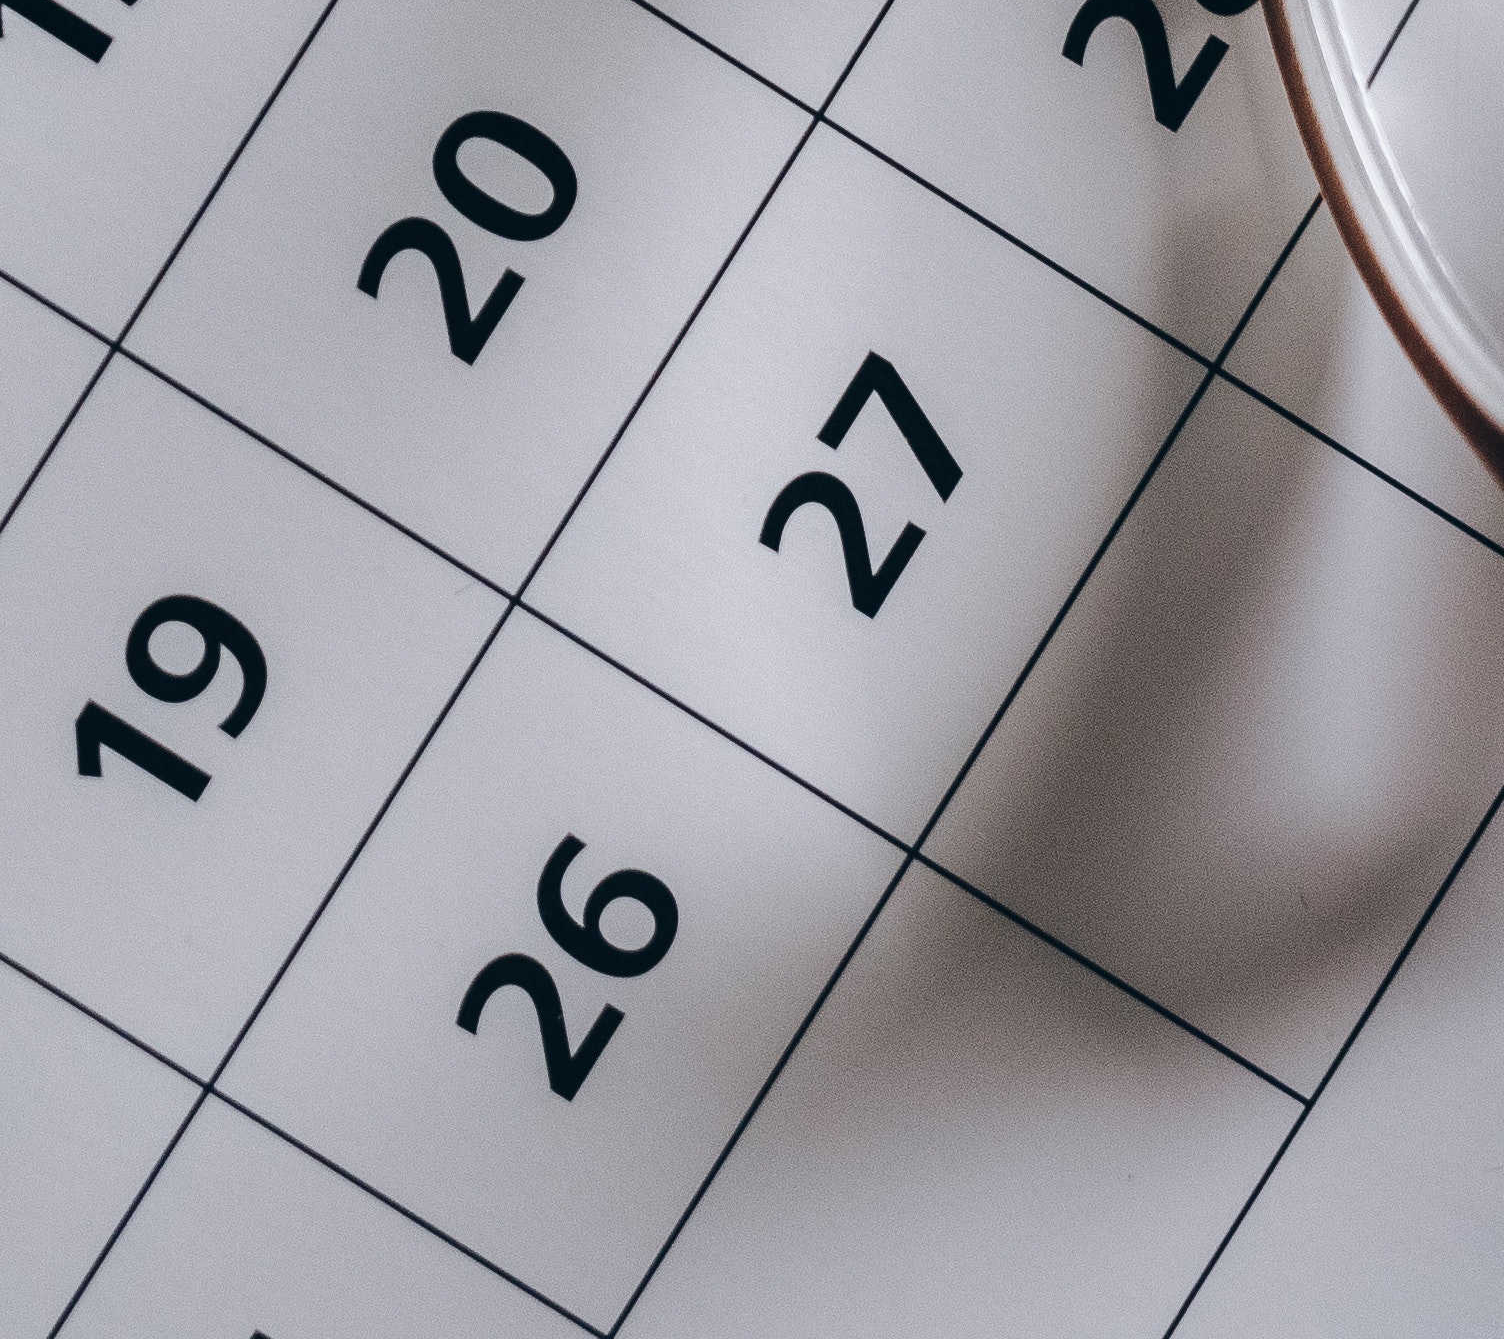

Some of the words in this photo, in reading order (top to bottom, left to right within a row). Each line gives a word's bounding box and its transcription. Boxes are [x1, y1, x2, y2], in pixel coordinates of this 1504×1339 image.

[357, 111, 577, 366] 20
[759, 351, 963, 619] 27
[75, 595, 267, 802] 19
[456, 834, 678, 1101] 26
